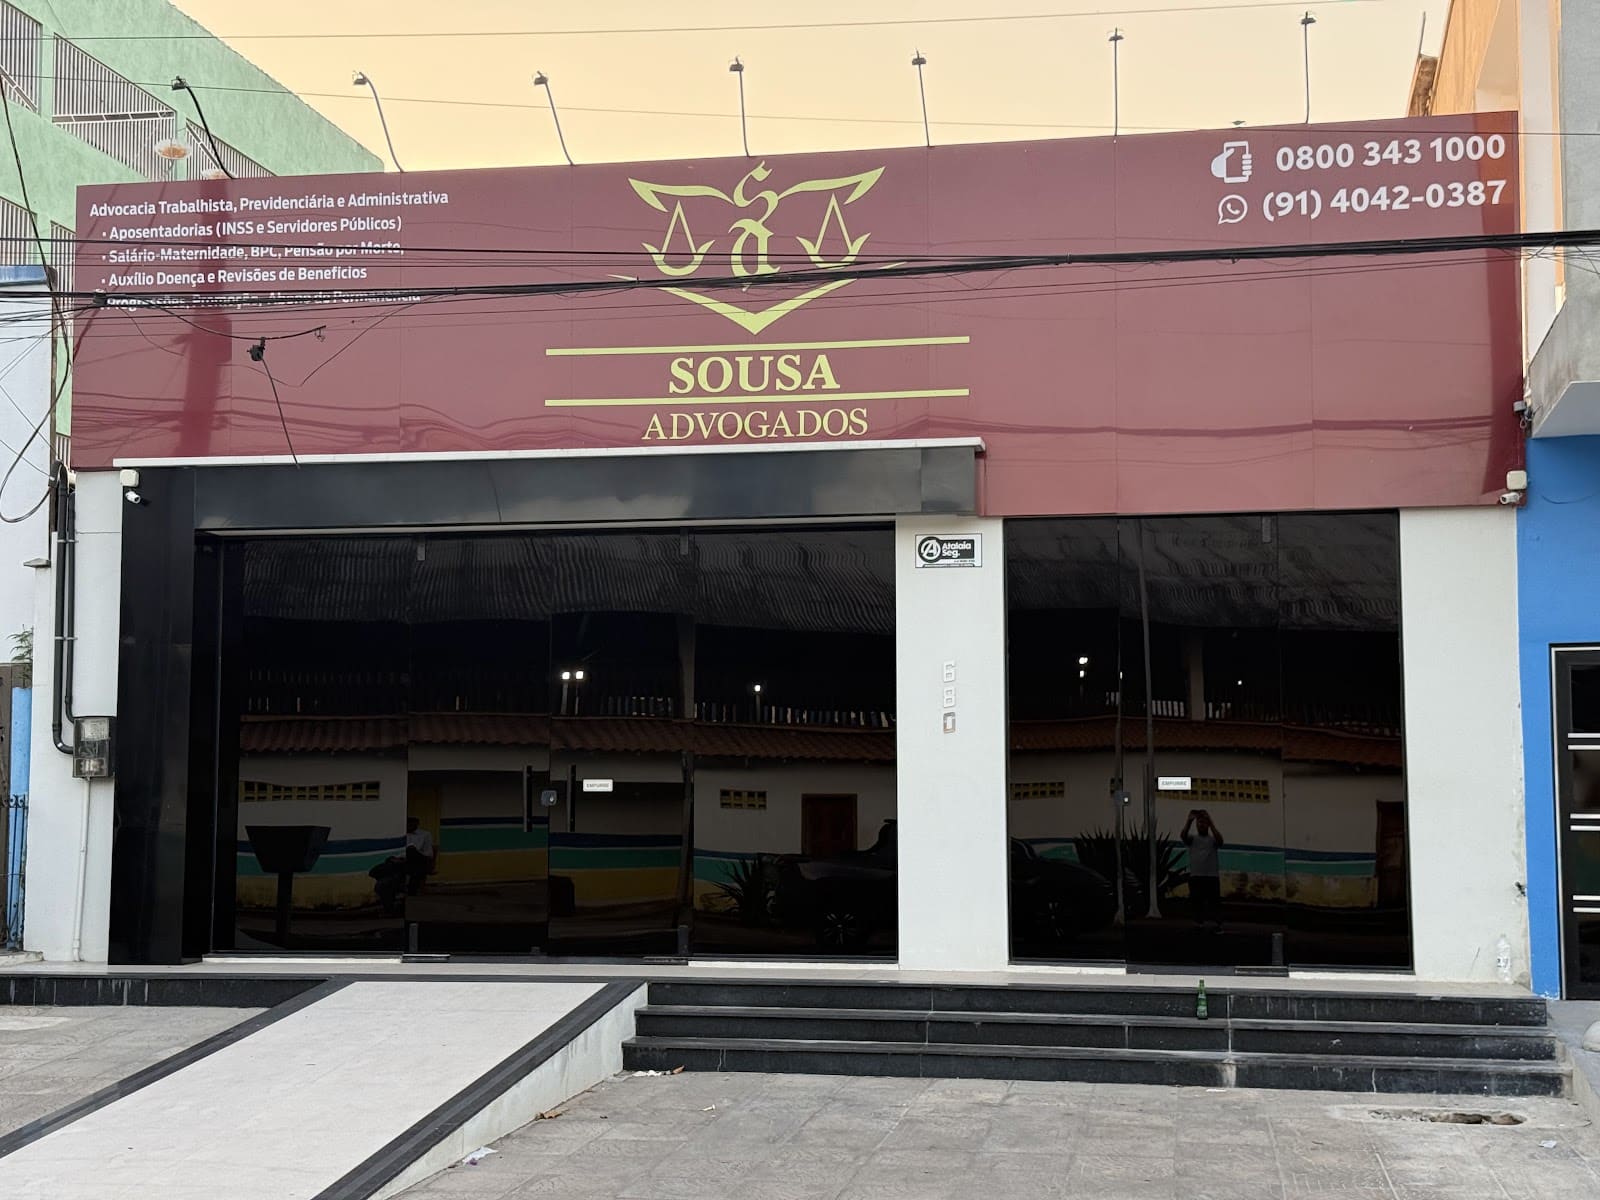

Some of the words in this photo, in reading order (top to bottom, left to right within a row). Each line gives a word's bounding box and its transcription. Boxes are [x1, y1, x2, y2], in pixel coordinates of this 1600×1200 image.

[1275, 143, 1354, 171] 0800
[1362, 139, 1423, 167] 343
[1430, 134, 1506, 162] 1000
[89, 203, 156, 217] Advocacia
[158, 199, 238, 214] Trabalhista,
[240, 194, 335, 210] Previdenciária
[337, 197, 345, 208] e
[348, 191, 449, 207] Administrativa
[1262, 189, 1322, 222] (91)
[1330, 179, 1507, 213] 4042-0387
[109, 224, 213, 241] Aposentadorias
[216, 221, 254, 238] (INSS
[256, 224, 265, 234] e
[266, 218, 338, 234] Servidores
[340, 215, 402, 232] Públicos)
[109, 245, 248, 263] Salário-Maternidade,
[250, 245, 282, 260] BPC,
[284, 243, 333, 258] Pensão
[335, 245, 358, 258] por
[360, 241, 404, 256] Morte,
[109, 271, 154, 287] Auxílio
[156, 269, 205, 288] Doença
[207, 273, 215, 283] e
[217, 267, 276, 283] Revisões
[278, 267, 295, 281] de
[668, 354, 841, 394] SOUSA
[641, 408, 869, 441] ADVOGADOS
[942, 541, 972, 551] Atalaia
[942, 549, 961, 558] Seg.
